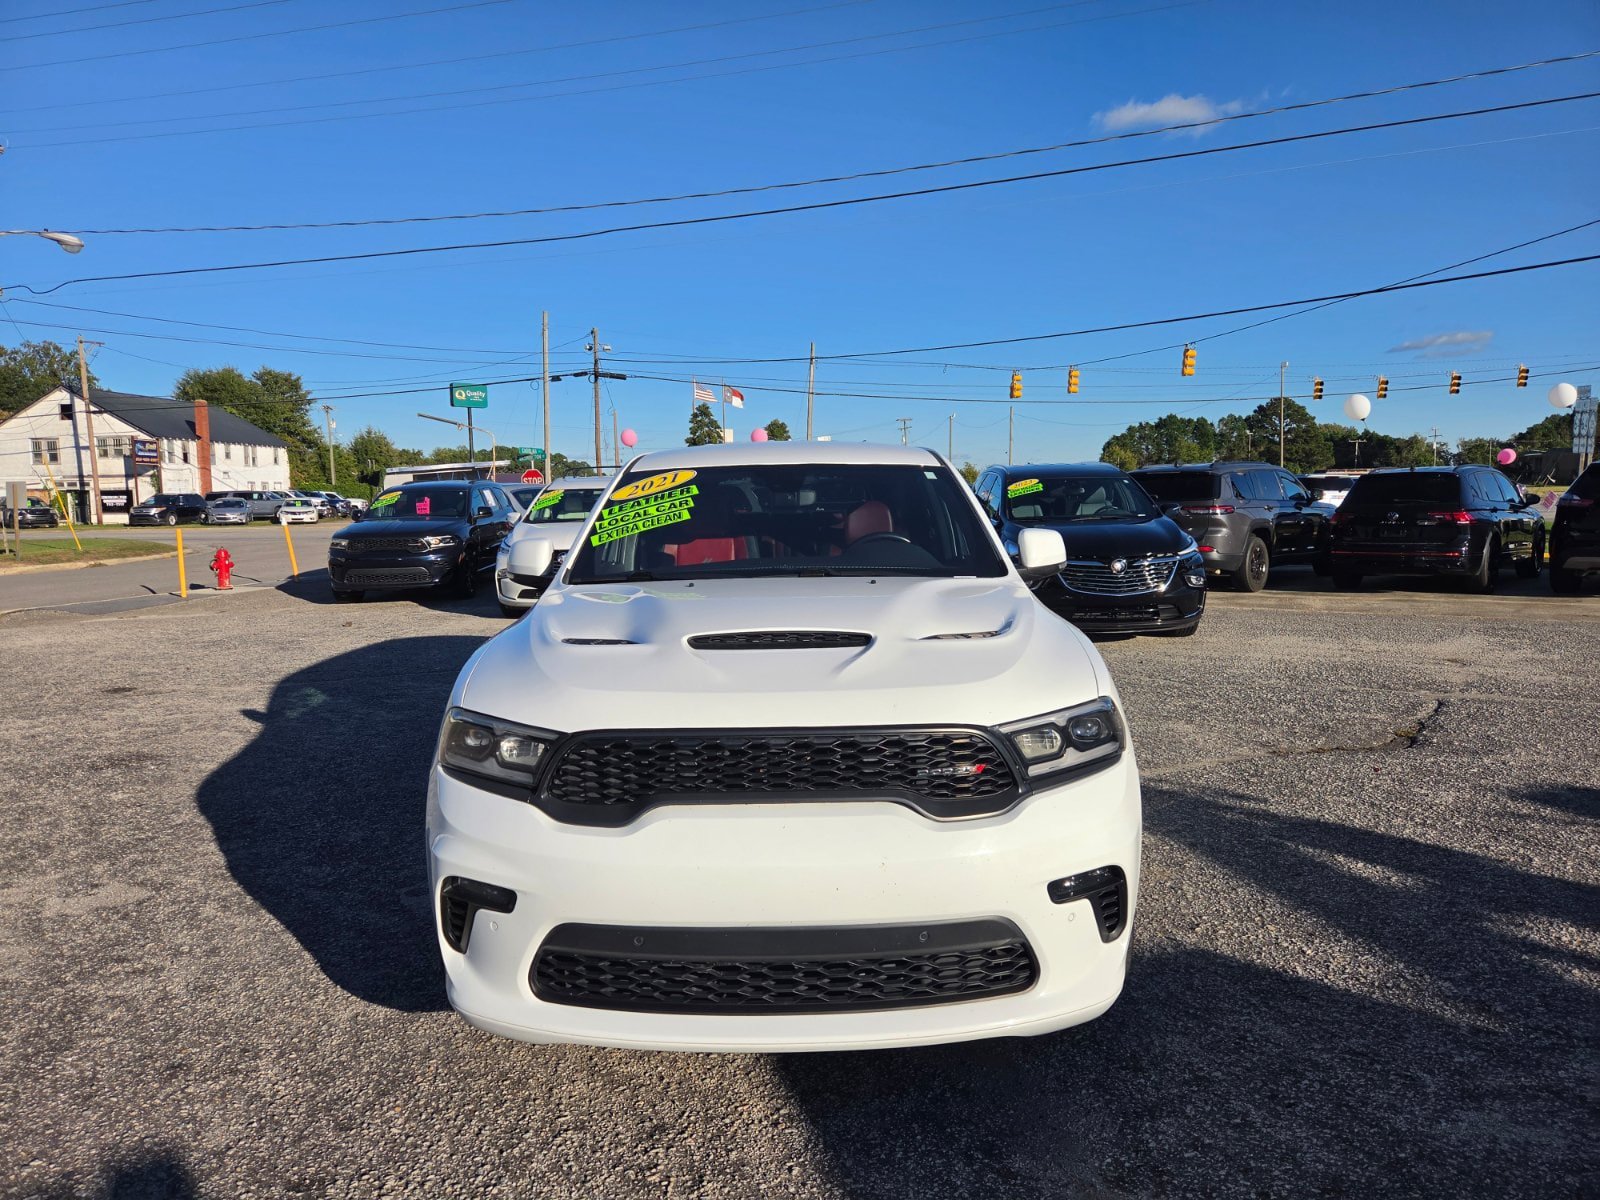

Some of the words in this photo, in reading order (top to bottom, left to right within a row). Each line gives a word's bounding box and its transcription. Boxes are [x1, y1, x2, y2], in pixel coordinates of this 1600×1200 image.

[466, 390, 486, 398] Quality
[628, 475, 678, 497] 2021
[599, 509, 652, 531] LOCAL
[656, 499, 690, 513] CAR
[608, 487, 691, 516] LEATHER
[598, 524, 640, 543] EXTRA
[642, 513, 682, 528] CLEAN
